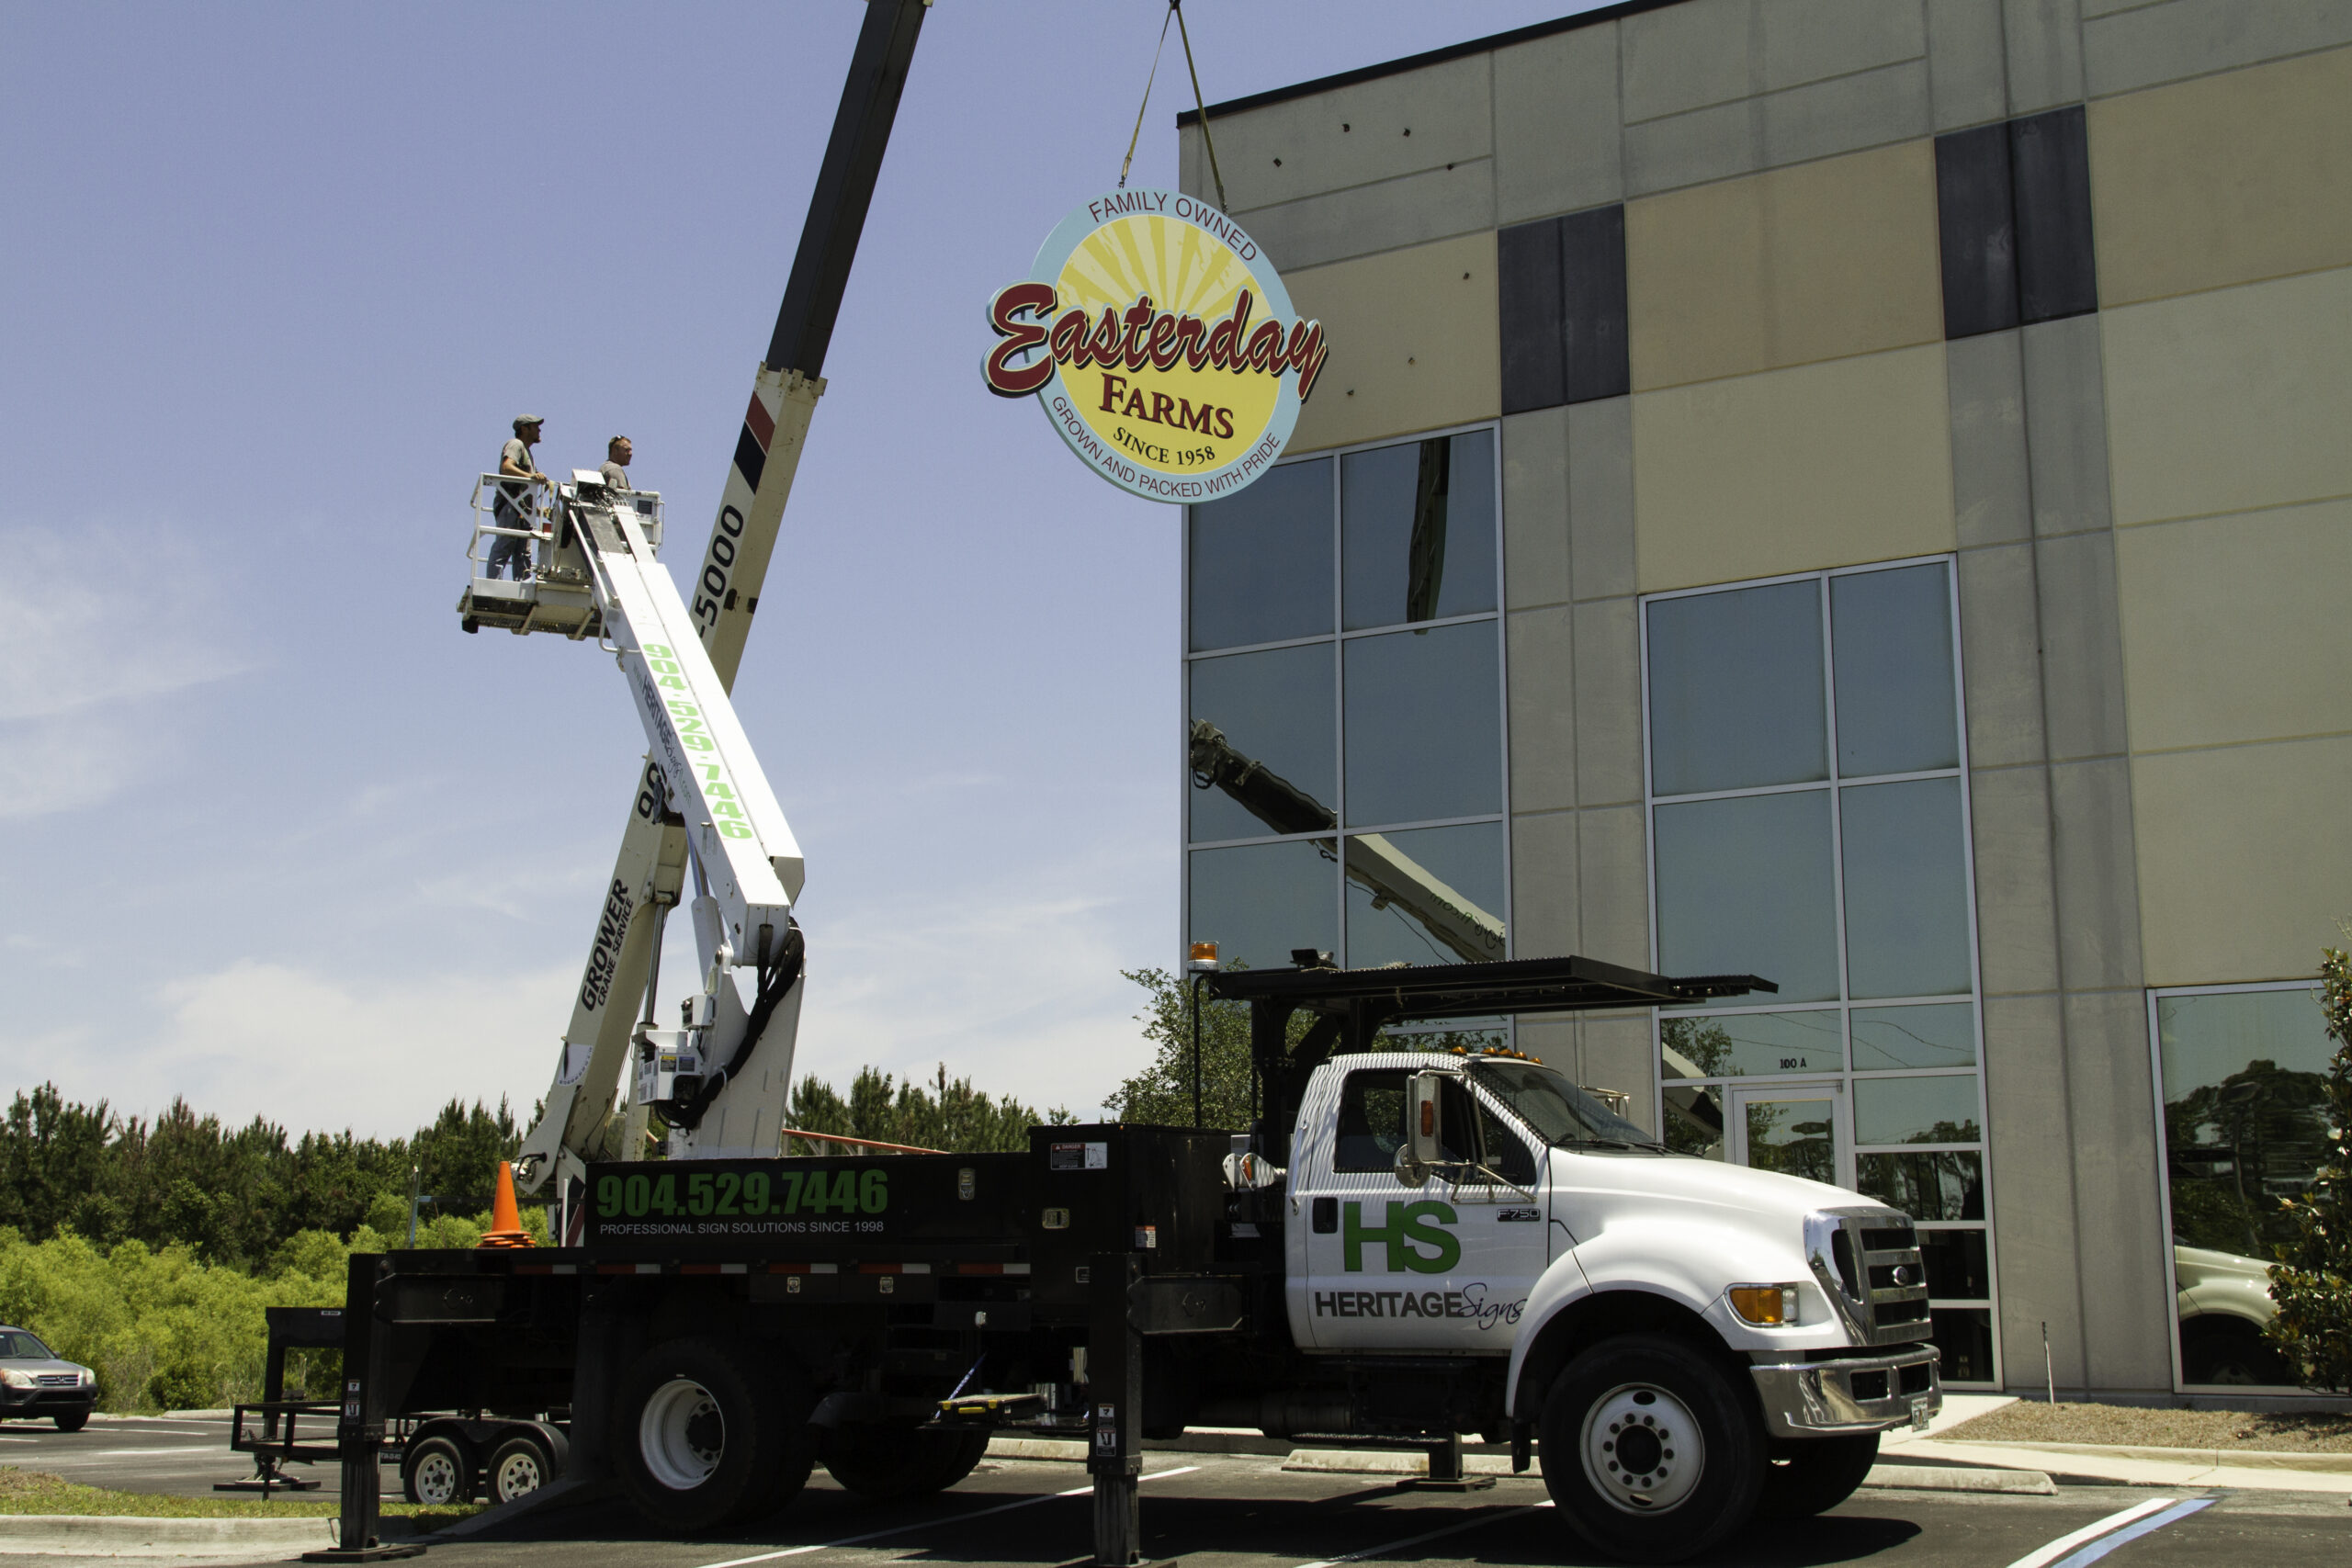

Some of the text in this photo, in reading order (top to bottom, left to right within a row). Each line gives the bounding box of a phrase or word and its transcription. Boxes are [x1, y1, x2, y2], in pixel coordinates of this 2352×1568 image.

[1089, 192, 1256, 261] FAMILY OWNED
[985, 282, 1328, 402] Easterday
[1099, 372, 1234, 439] FARMS
[1053, 396, 1280, 498] GROWN AND PACKED WITH PRIDE
[1114, 427, 1216, 466] SINCE 1958
[581, 878, 628, 1011] GROWER
[597, 897, 634, 1007] CRANE SERVICE
[1780, 1057, 1807, 1069] 100 A
[597, 1169, 888, 1218] 904.529.7446
[600, 1221, 884, 1235] PROFESSIONAL SIGN SOLUTIONS SINCE 1998
[1343, 1200, 1461, 1273] HS
